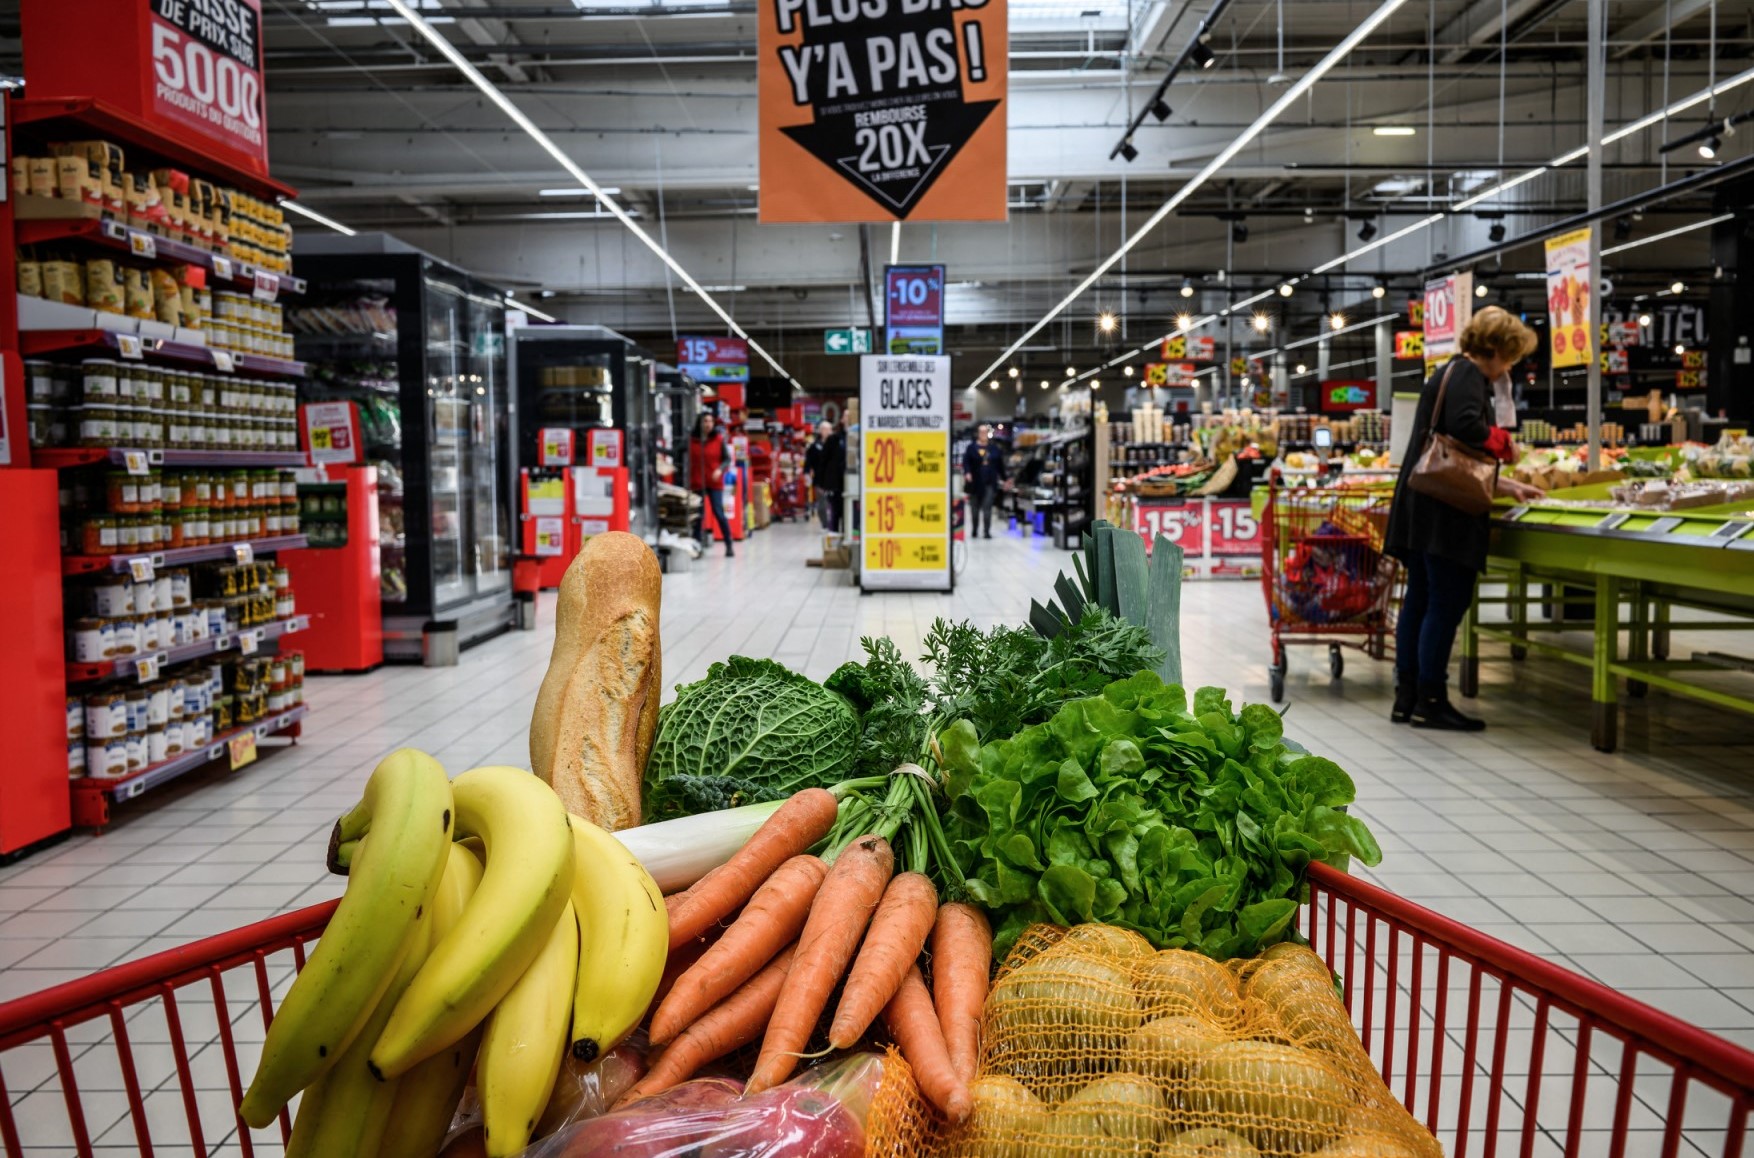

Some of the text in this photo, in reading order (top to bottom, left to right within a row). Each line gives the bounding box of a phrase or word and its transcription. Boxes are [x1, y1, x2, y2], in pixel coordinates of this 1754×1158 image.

[160, 0, 254, 68] DE PRIX SUR
[866, 28, 957, 92] PAS
[152, 22, 260, 129] 5000
[854, 104, 928, 128] REMBOURSE
[855, 121, 932, 173] 20X
[880, 378, 932, 410] GLACES
